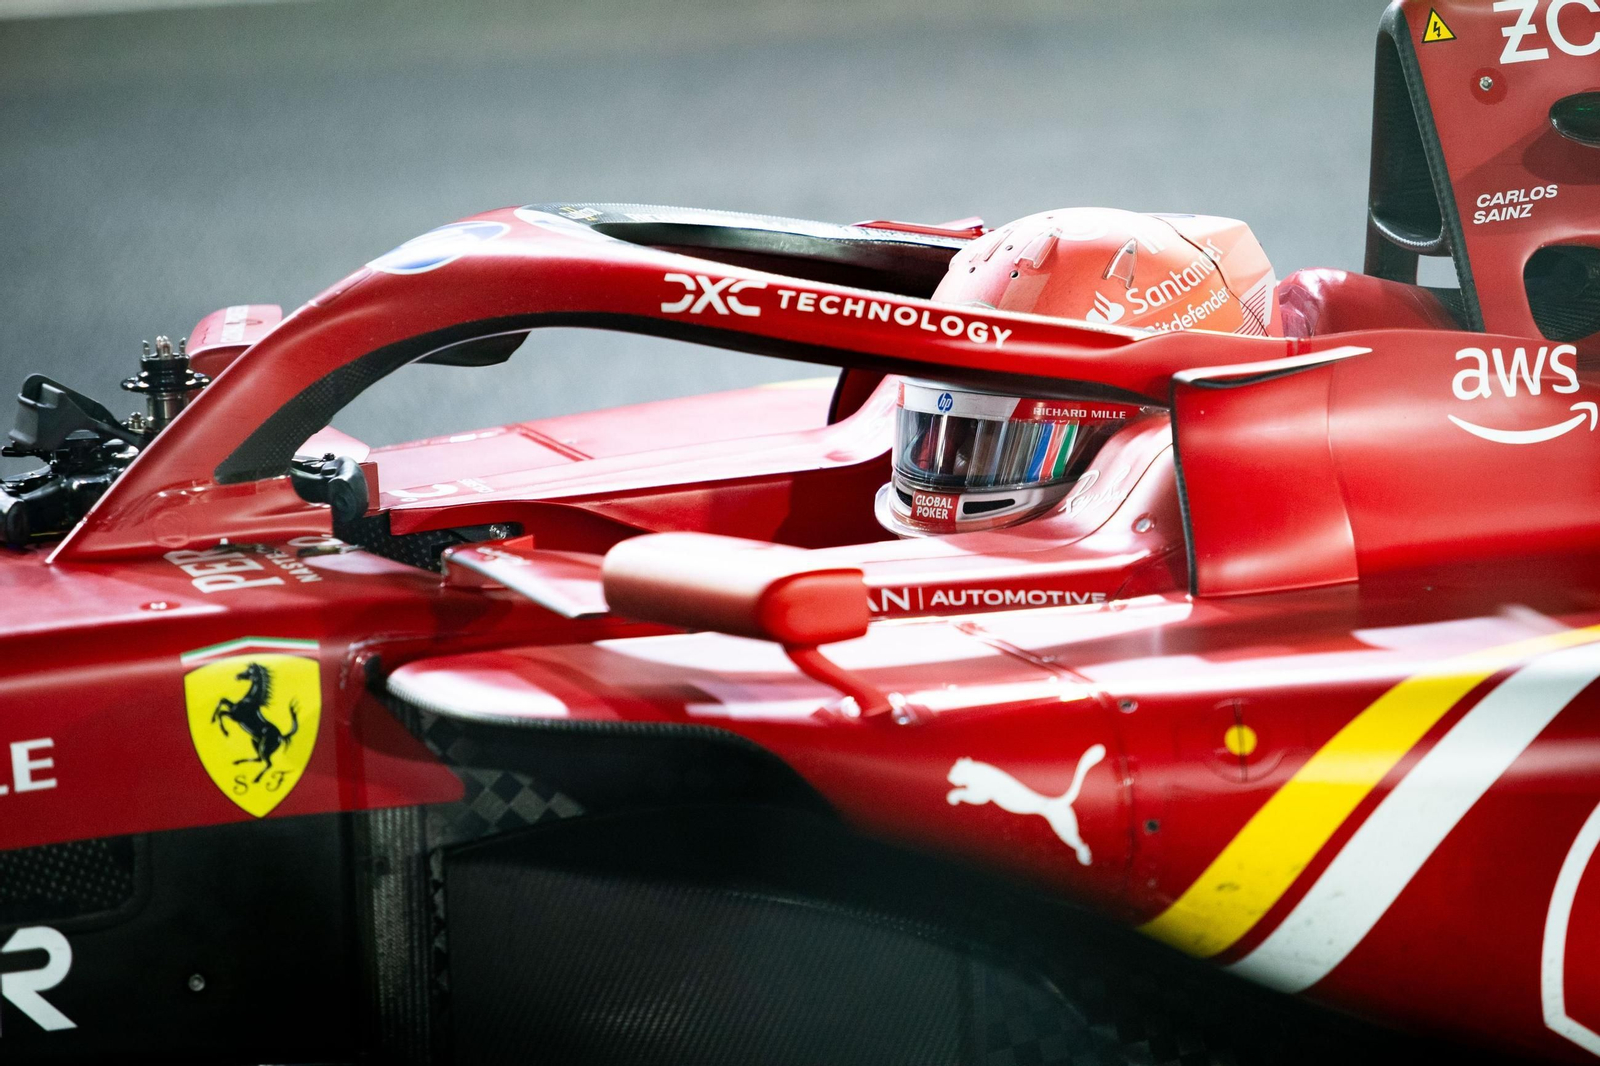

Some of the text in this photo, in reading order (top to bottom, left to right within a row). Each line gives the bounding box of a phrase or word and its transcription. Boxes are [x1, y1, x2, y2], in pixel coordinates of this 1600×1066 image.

[1476, 184, 1558, 208] CARLOS
[1473, 204, 1533, 225] SAINZ
[1125, 238, 1223, 315] Santander
[660, 273, 1012, 349] DXC TECHNOLOGY
[1144, 286, 1230, 331] tdefender
[1452, 344, 1580, 400] aws
[938, 392, 953, 412] hp
[1033, 407, 1126, 419] RICHARD MILLE
[915, 494, 953, 509] GLOBAL
[916, 504, 949, 520] POKER
[930, 589, 1107, 604] AUTOMOTIVE
[0, 737, 57, 795] E
